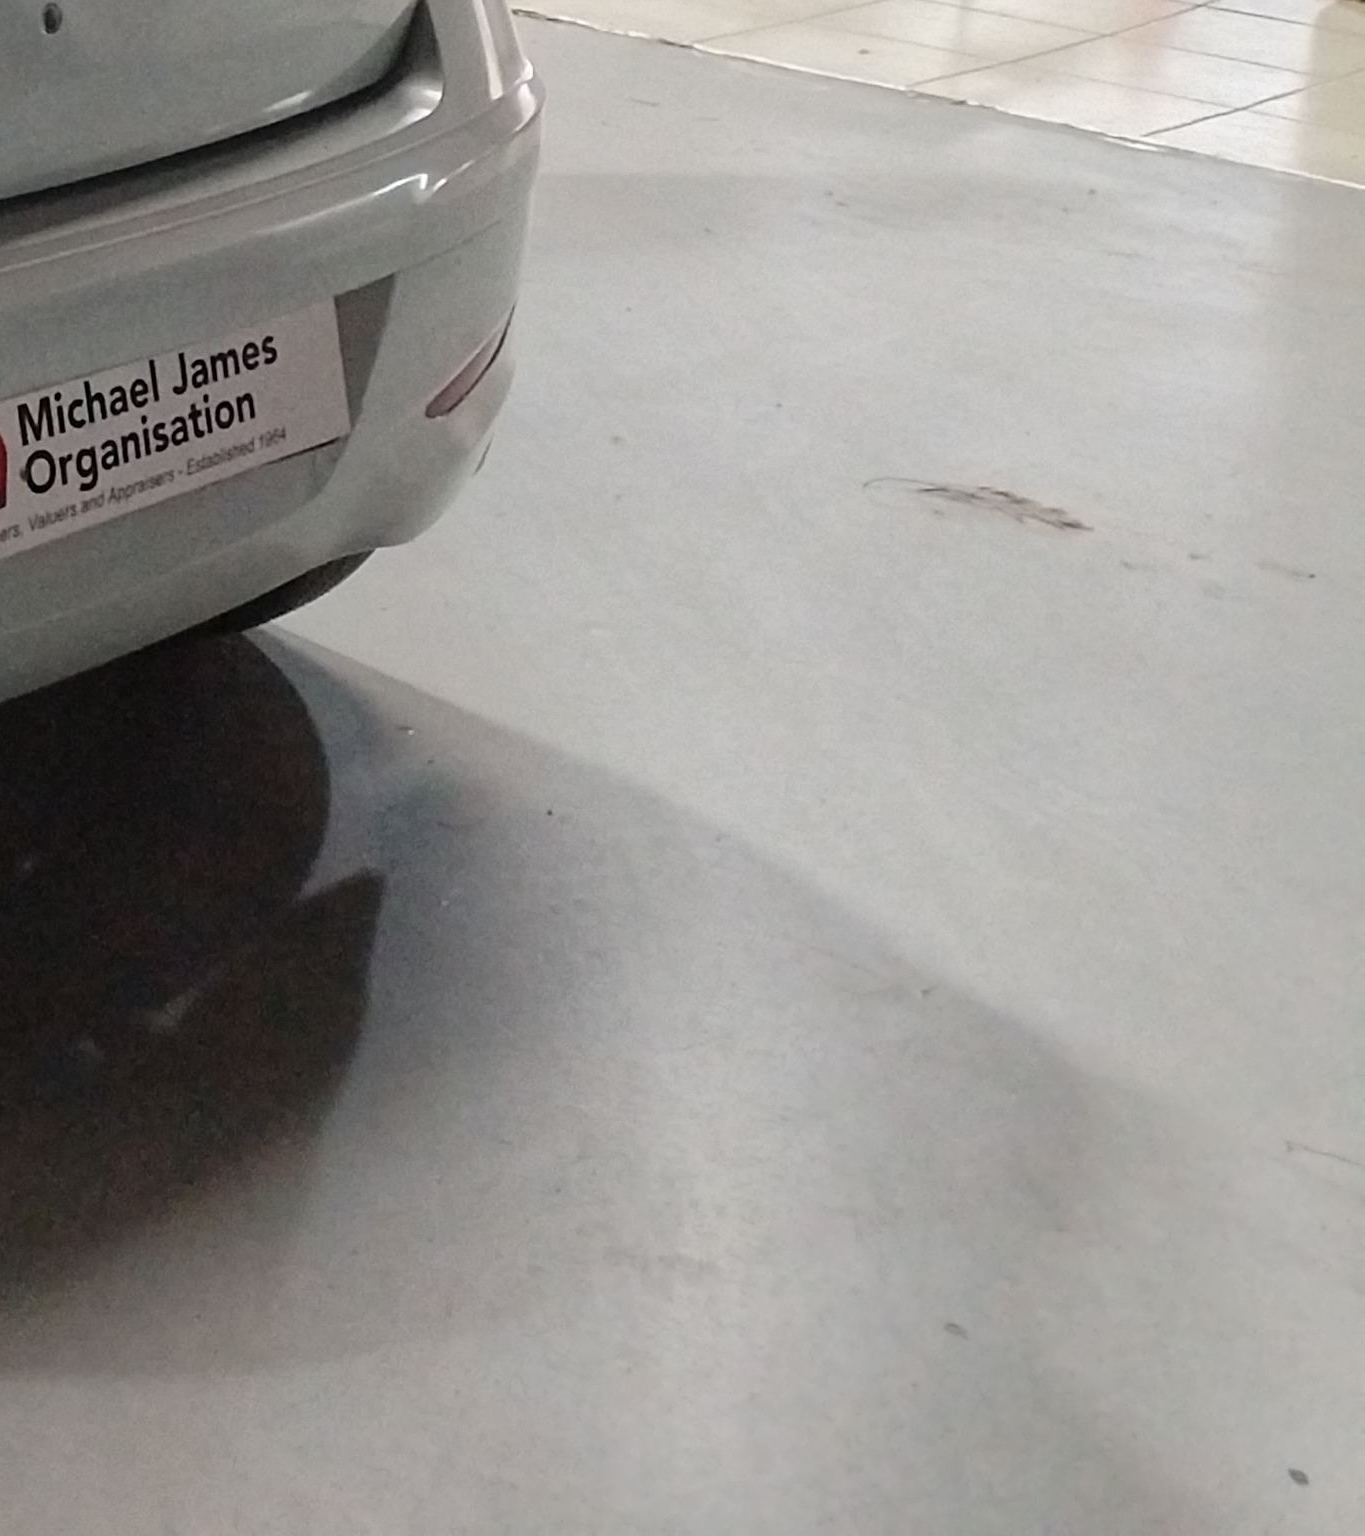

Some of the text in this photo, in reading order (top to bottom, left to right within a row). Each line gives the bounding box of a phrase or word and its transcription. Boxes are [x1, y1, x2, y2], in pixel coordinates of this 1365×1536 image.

[17, 335, 278, 446] Michael James
[24, 392, 257, 494] Organisation
[27, 502, 77, 532] Valuers
[80, 494, 105, 514] and
[107, 470, 176, 510] Appraisers
[186, 441, 255, 477] Established
[256, 427, 287, 452] 1964
